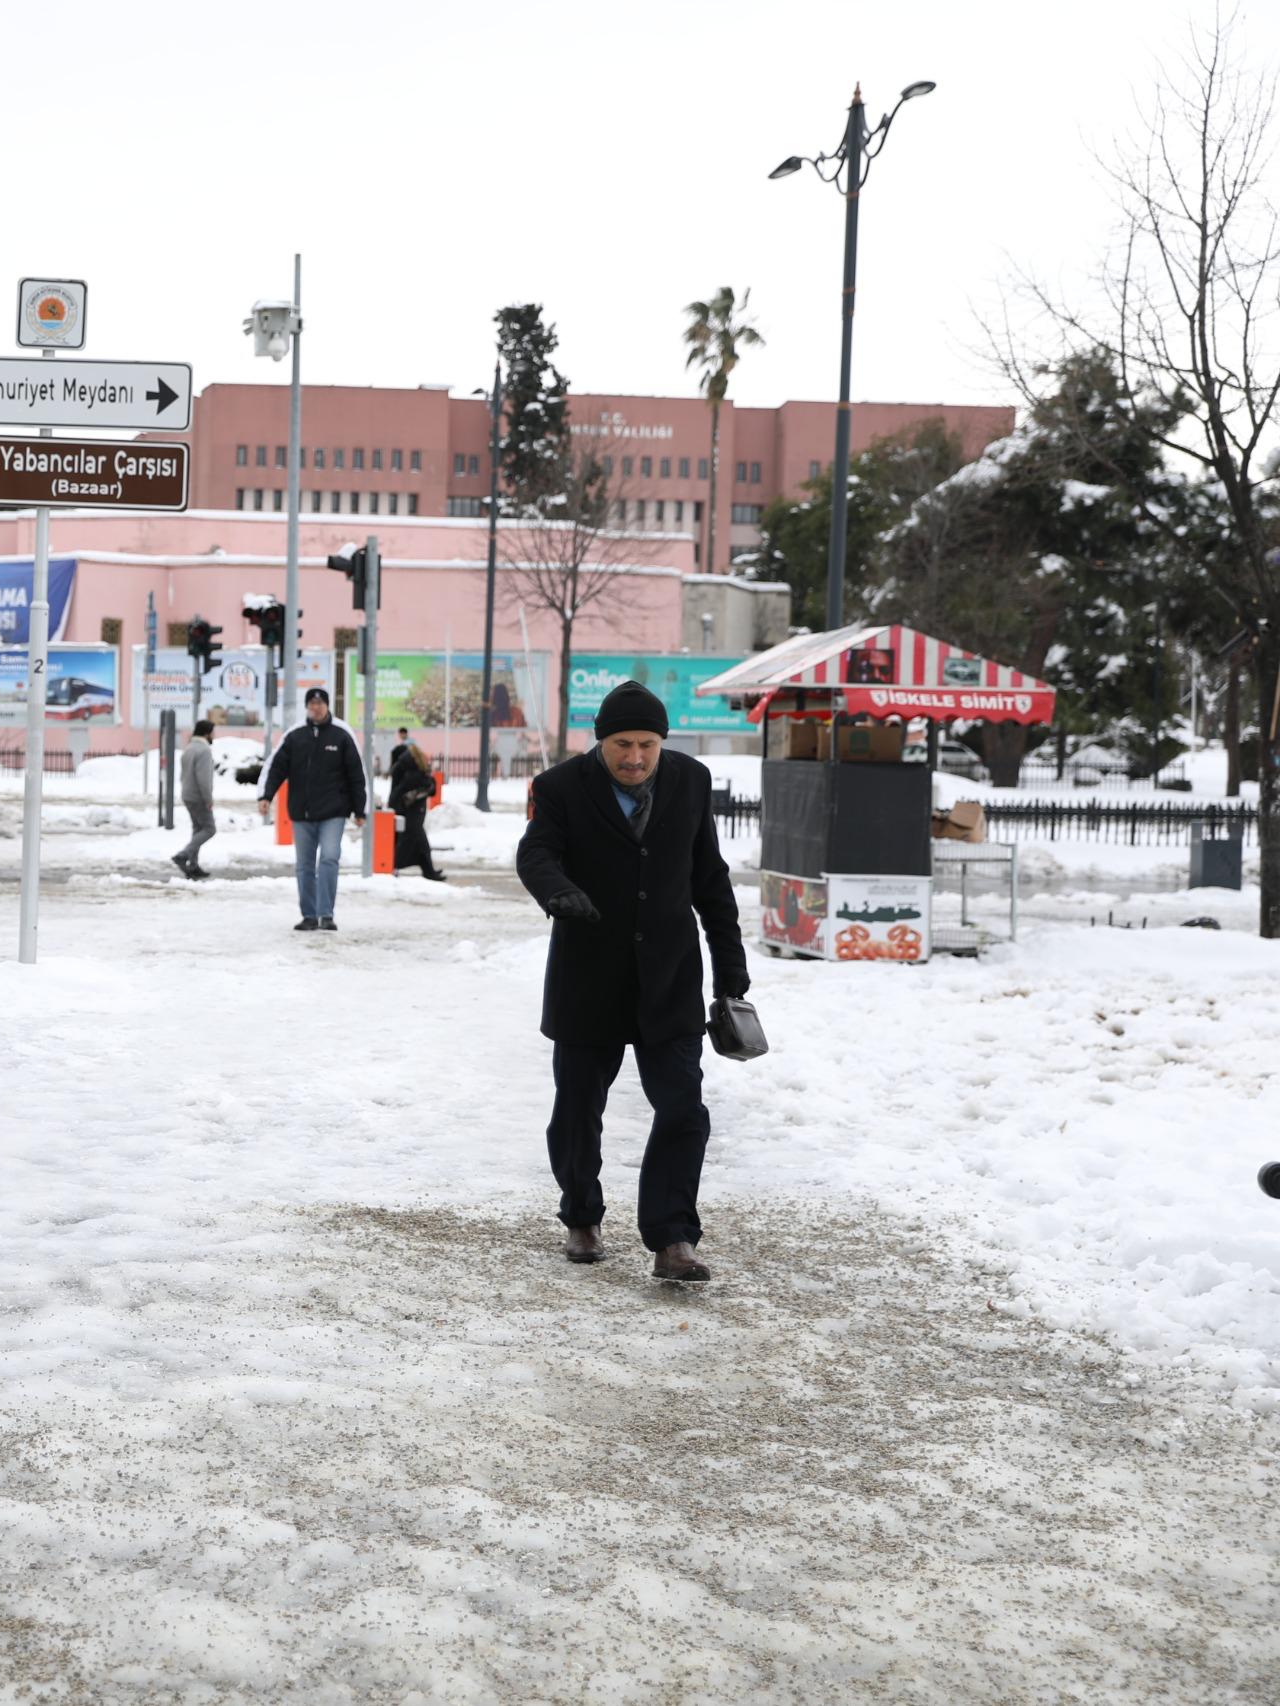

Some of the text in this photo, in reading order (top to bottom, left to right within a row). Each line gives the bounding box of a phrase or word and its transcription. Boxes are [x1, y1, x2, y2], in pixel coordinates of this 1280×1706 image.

[62, 377, 133, 409] Meydanı
[0, 445, 177, 480] Yabancılar Çarşısı
[51, 479, 123, 500] (Bazaar)
[33, 658, 45, 674] 2
[888, 688, 1016, 711] İSKELE SİMİT
